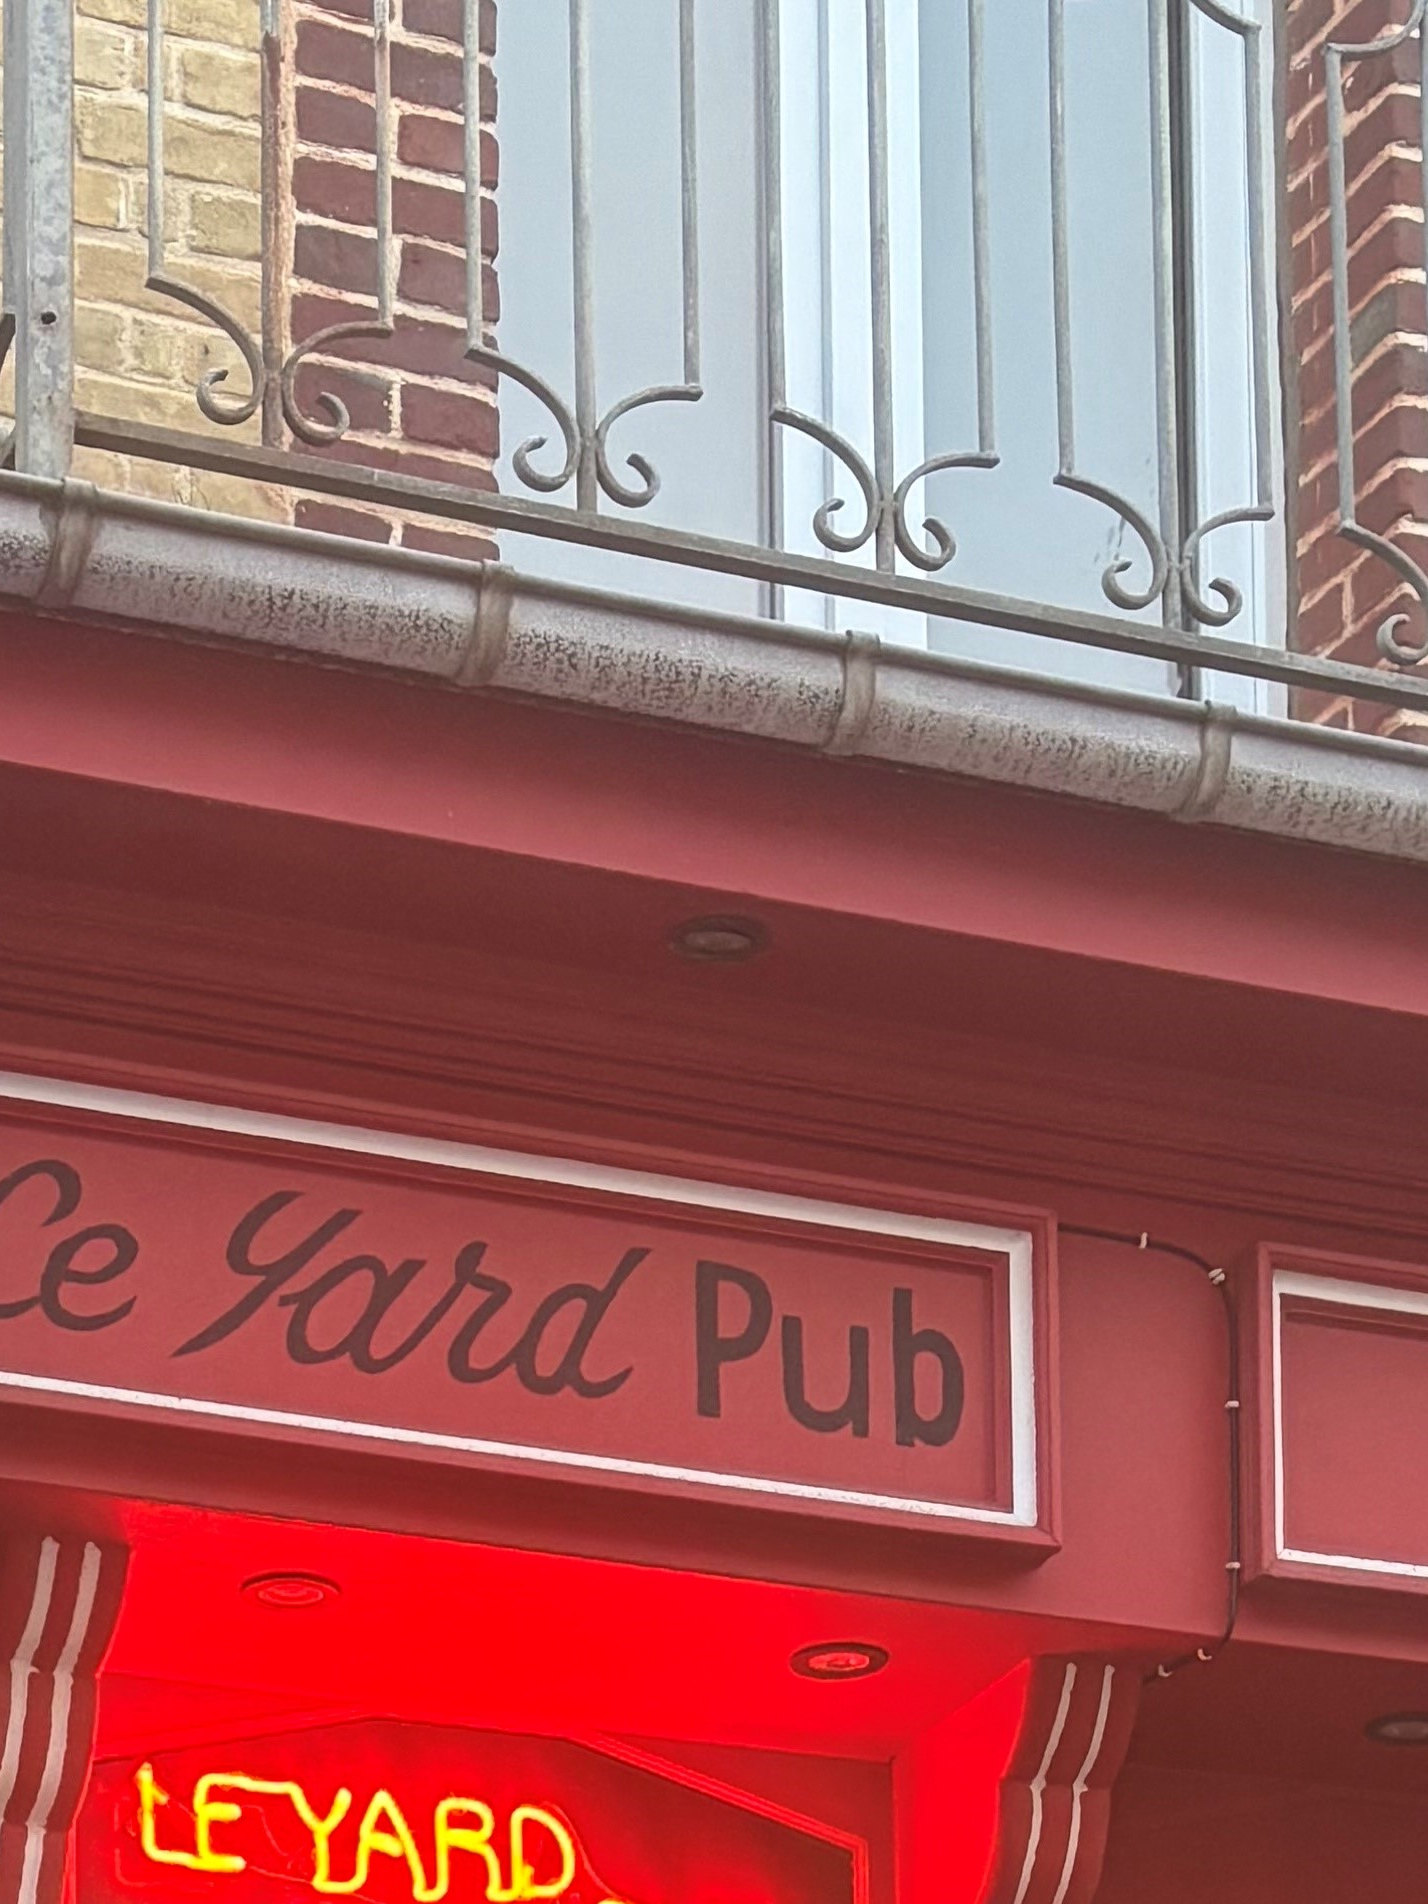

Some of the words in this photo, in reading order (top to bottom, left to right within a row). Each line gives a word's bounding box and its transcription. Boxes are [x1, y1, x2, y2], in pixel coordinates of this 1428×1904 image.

[174, 1190, 650, 1400] Yard
[692, 1258, 966, 1448] Pub
[137, 1762, 307, 1872] LE
[297, 1785, 576, 1903] YARD
